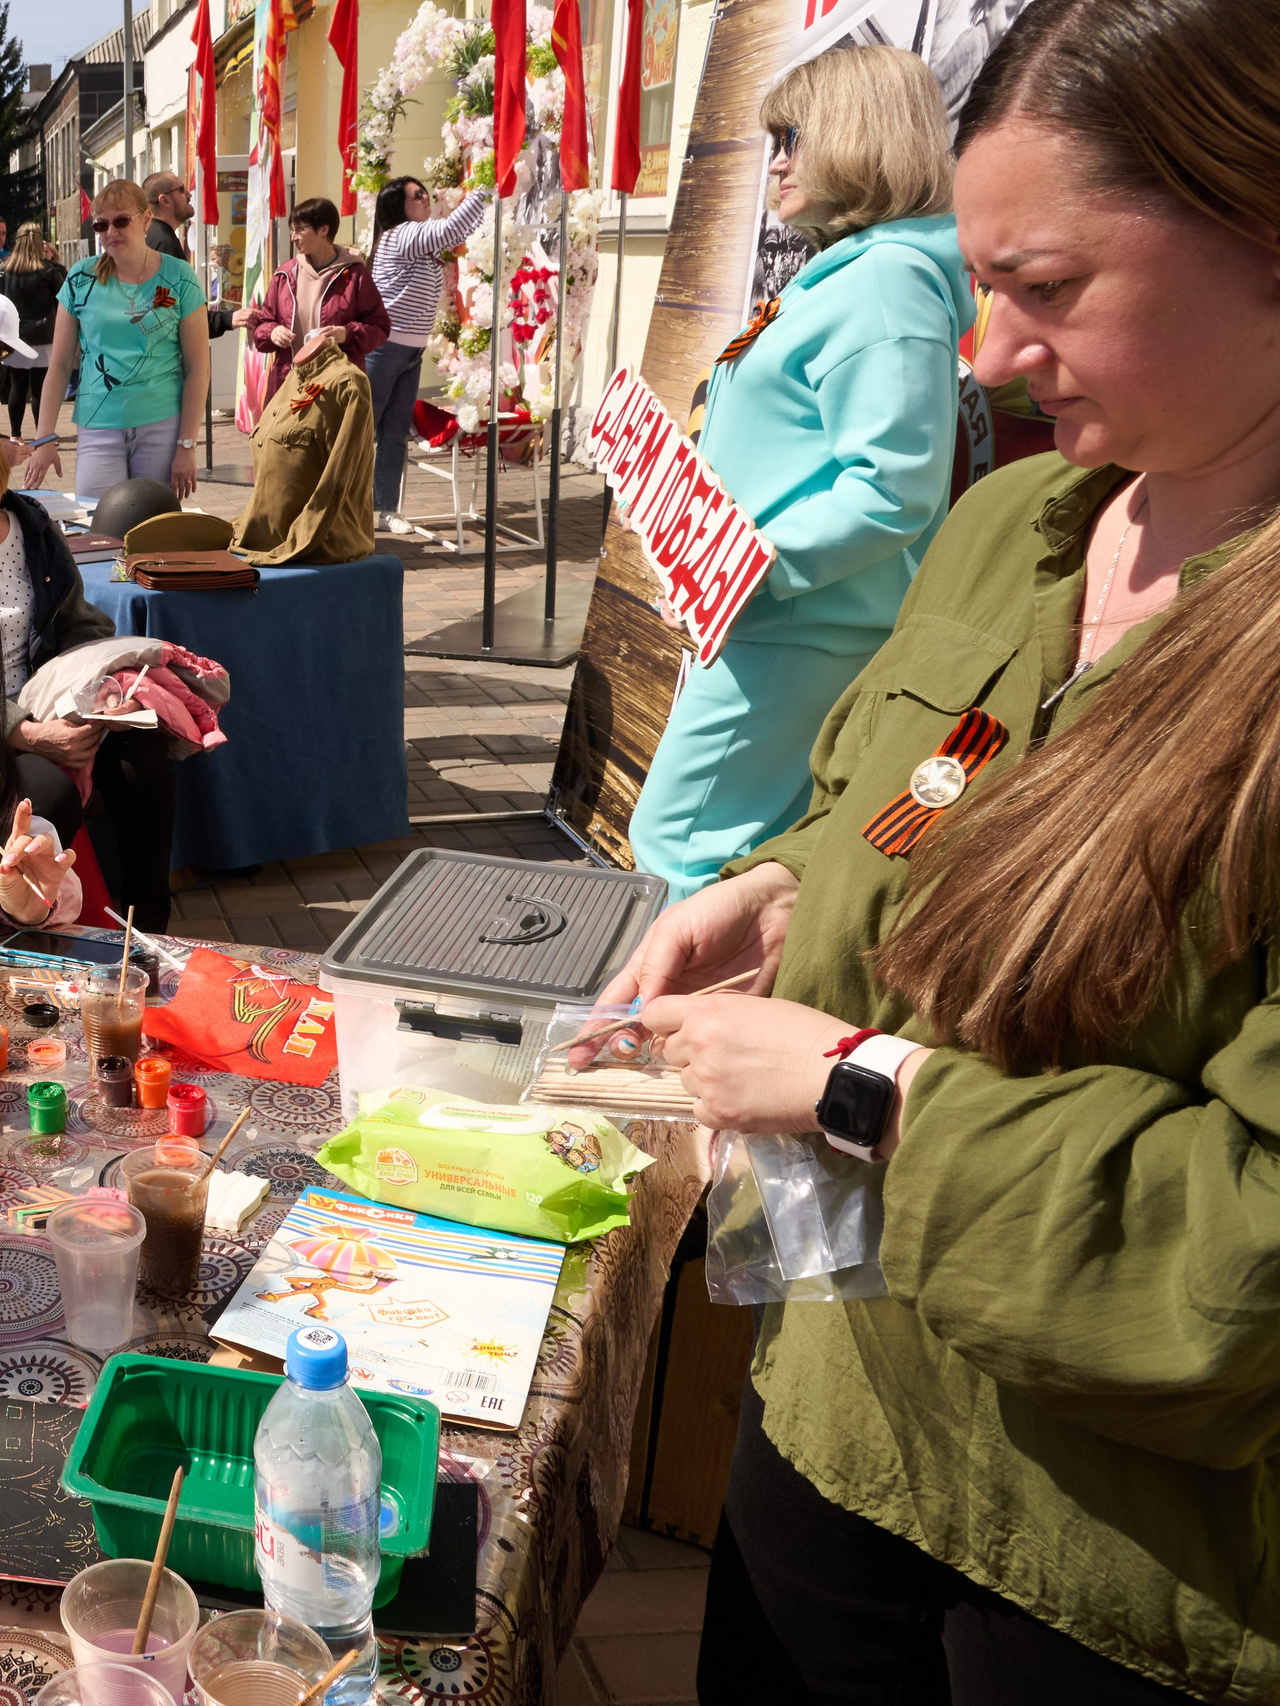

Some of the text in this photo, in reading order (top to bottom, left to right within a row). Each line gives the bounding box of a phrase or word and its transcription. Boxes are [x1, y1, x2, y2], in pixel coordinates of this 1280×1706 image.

[643, 36, 672, 88] 9 МАЯ
[639, 438, 770, 662] ПОБЕДЫ!
[438, 1163, 504, 1180] влажные салфетки
[424, 1169, 517, 1198] УНИВЕРСАЛЬНЫЕ
[440, 1183, 502, 1200] ДЛЯ ВСЕЙ СЕМЬИ
[525, 1192, 543, 1205] 120
[480, 1395, 506, 1411] EAC
